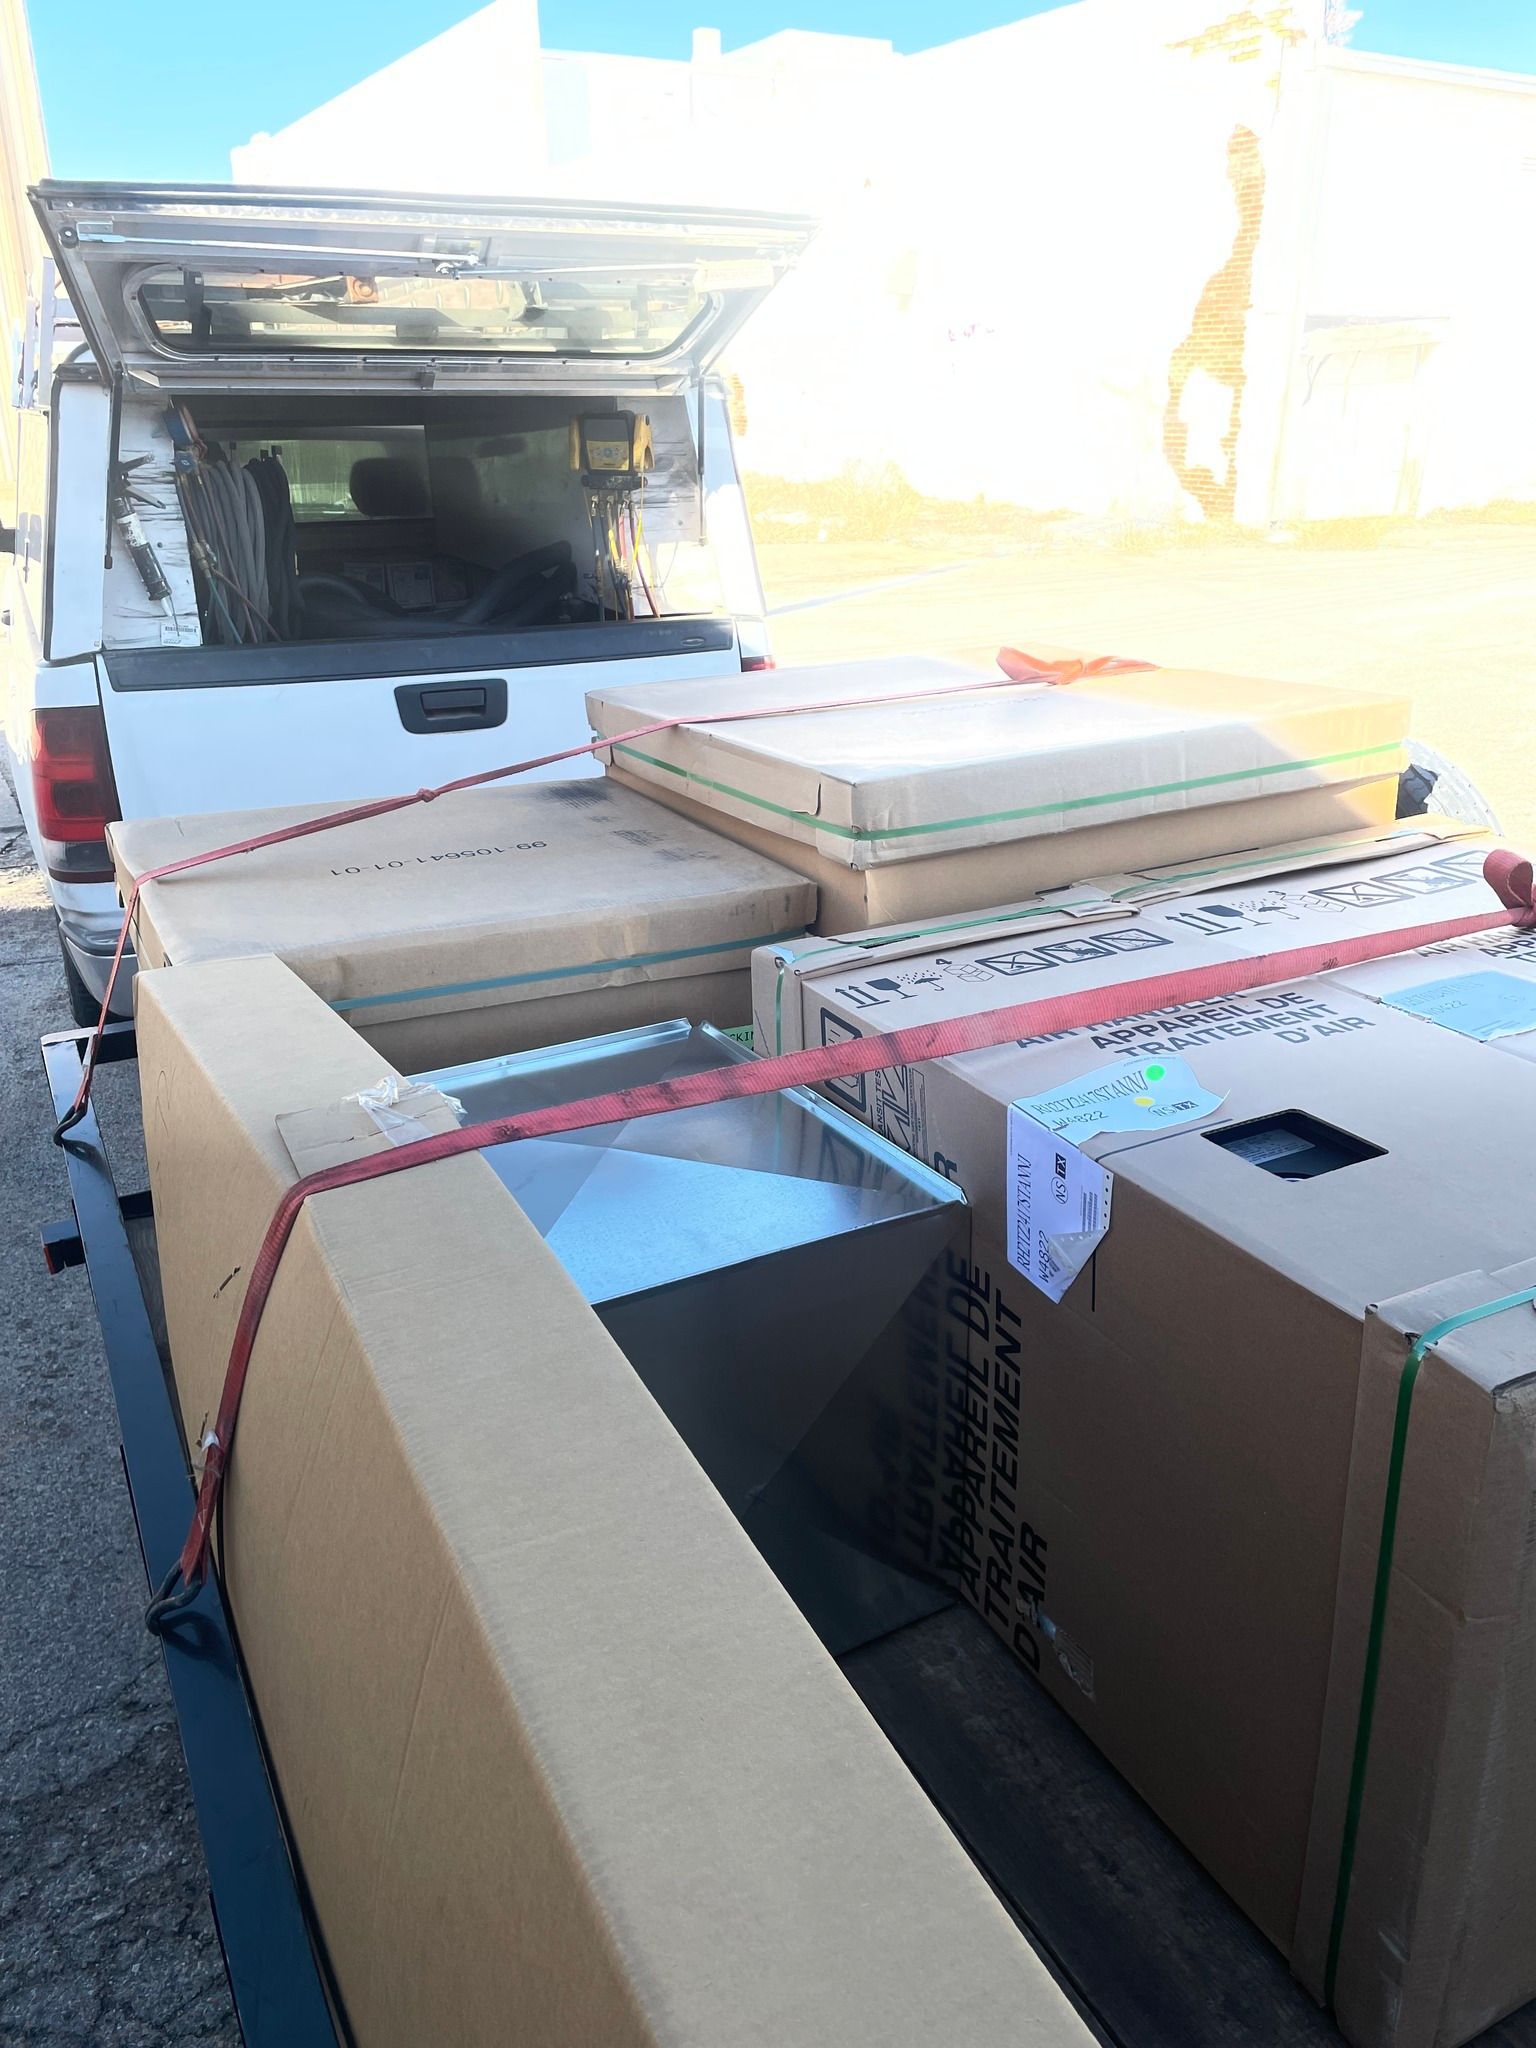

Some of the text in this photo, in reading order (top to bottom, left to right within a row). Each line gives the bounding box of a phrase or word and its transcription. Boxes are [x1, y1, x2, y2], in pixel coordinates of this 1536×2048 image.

[330, 840, 548, 876] 99-105641-01-01
[1091, 992, 1315, 1049] APPAREIL DE
[1115, 1003, 1339, 1057] TRAITEMENT
[1273, 1016, 1377, 1044] D'AIR
[1055, 1153, 1067, 1179] TX
[1038, 1229, 1050, 1284] W4822
[984, 1288, 1022, 1629] TRAITEMENT
